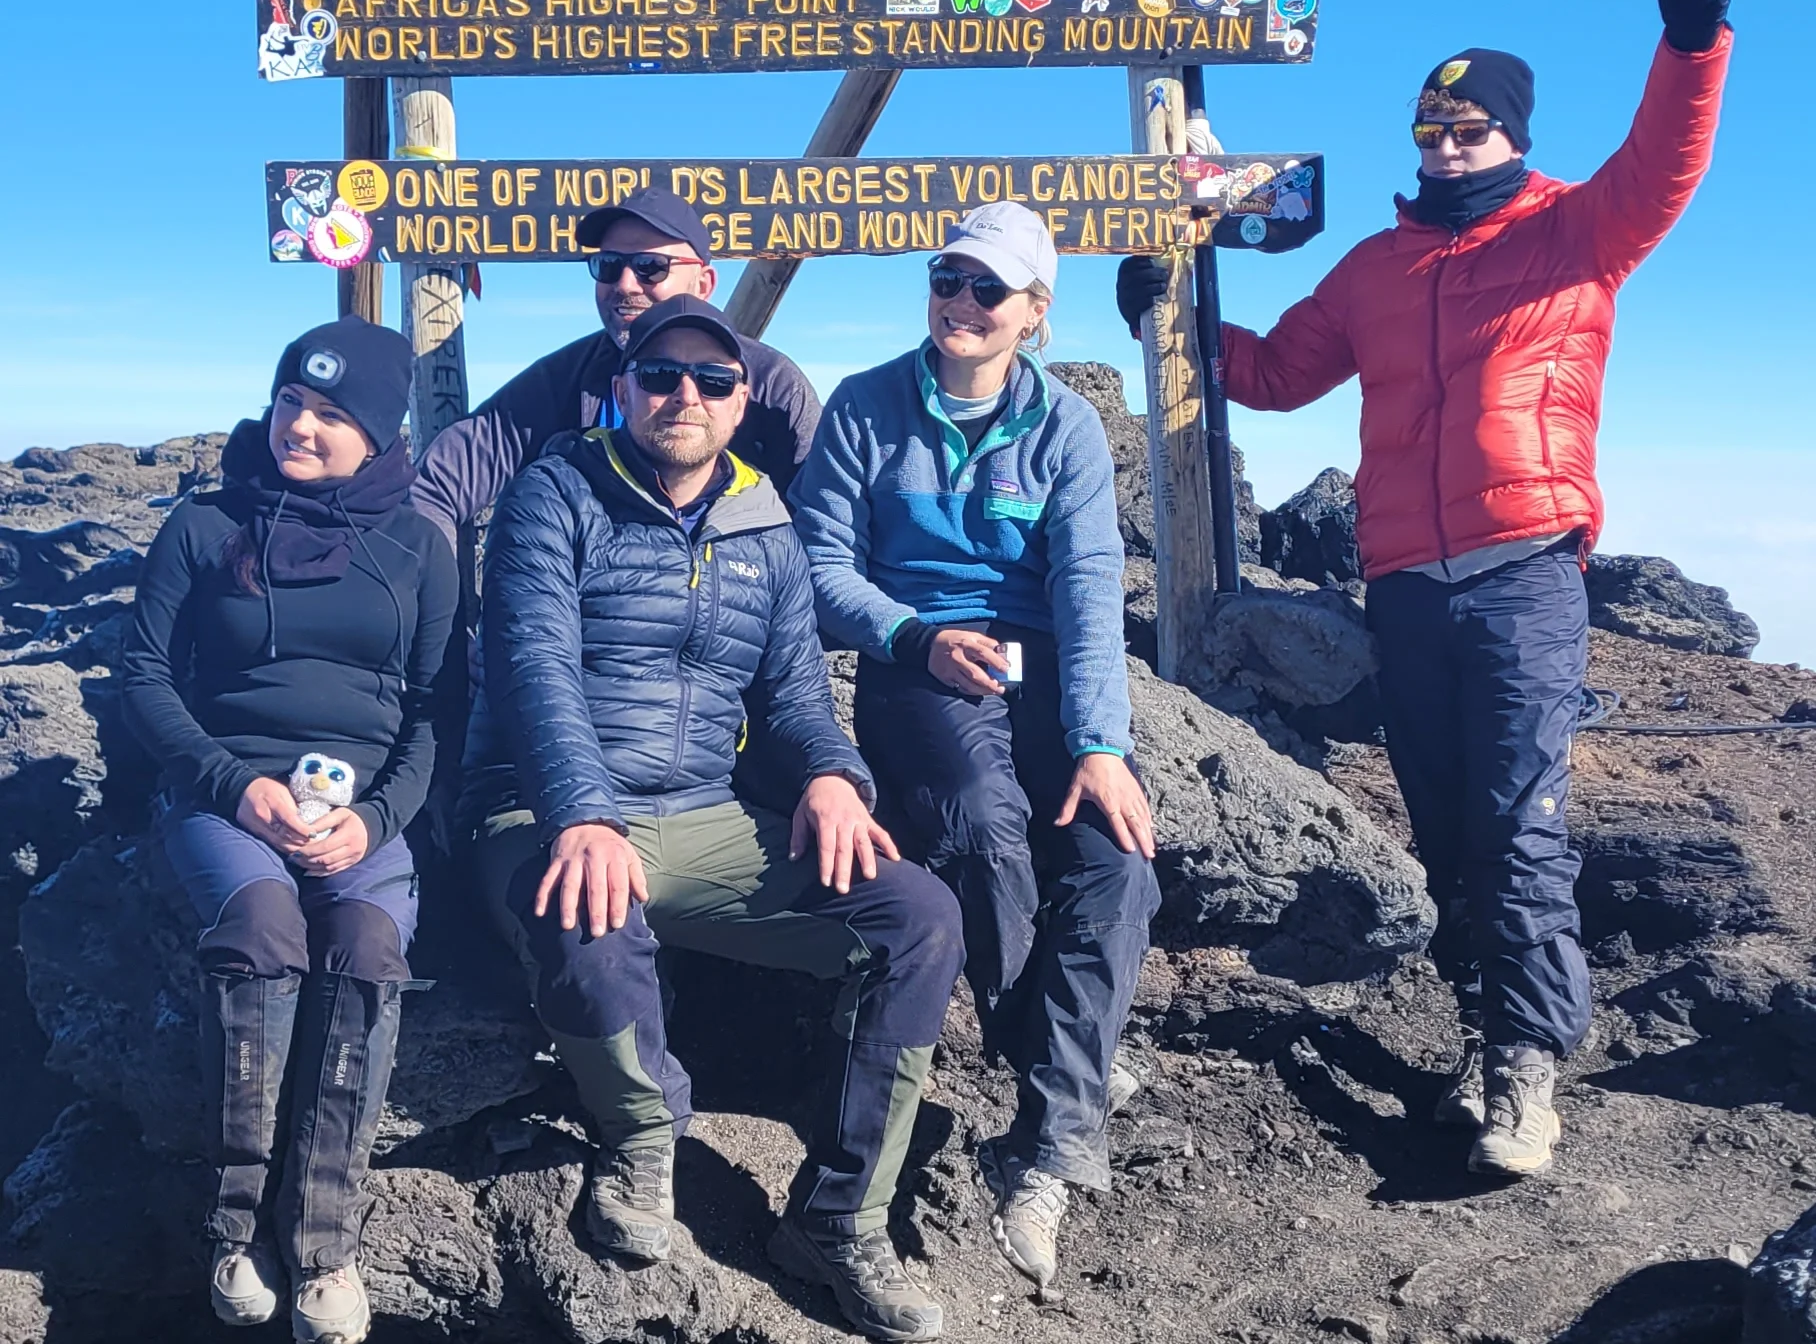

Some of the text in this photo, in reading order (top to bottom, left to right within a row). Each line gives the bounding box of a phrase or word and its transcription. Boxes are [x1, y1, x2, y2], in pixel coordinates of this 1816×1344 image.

[334, 24, 517, 62] WORLD'S
[532, 23, 719, 58] HIGHEST
[1064, 16, 1254, 52] MOUNTAIN
[395, 167, 479, 207] ONE
[491, 168, 541, 207] OF
[739, 163, 937, 205] LARGEST
[949, 163, 1182, 203] VOLCANOES
[395, 213, 537, 254] WORLD
[767, 210, 843, 250] AND
[738, 561, 760, 579] Rab
[240, 1041, 250, 1081] UNIGEAR
[334, 1043, 351, 1086] UNIGEAR
